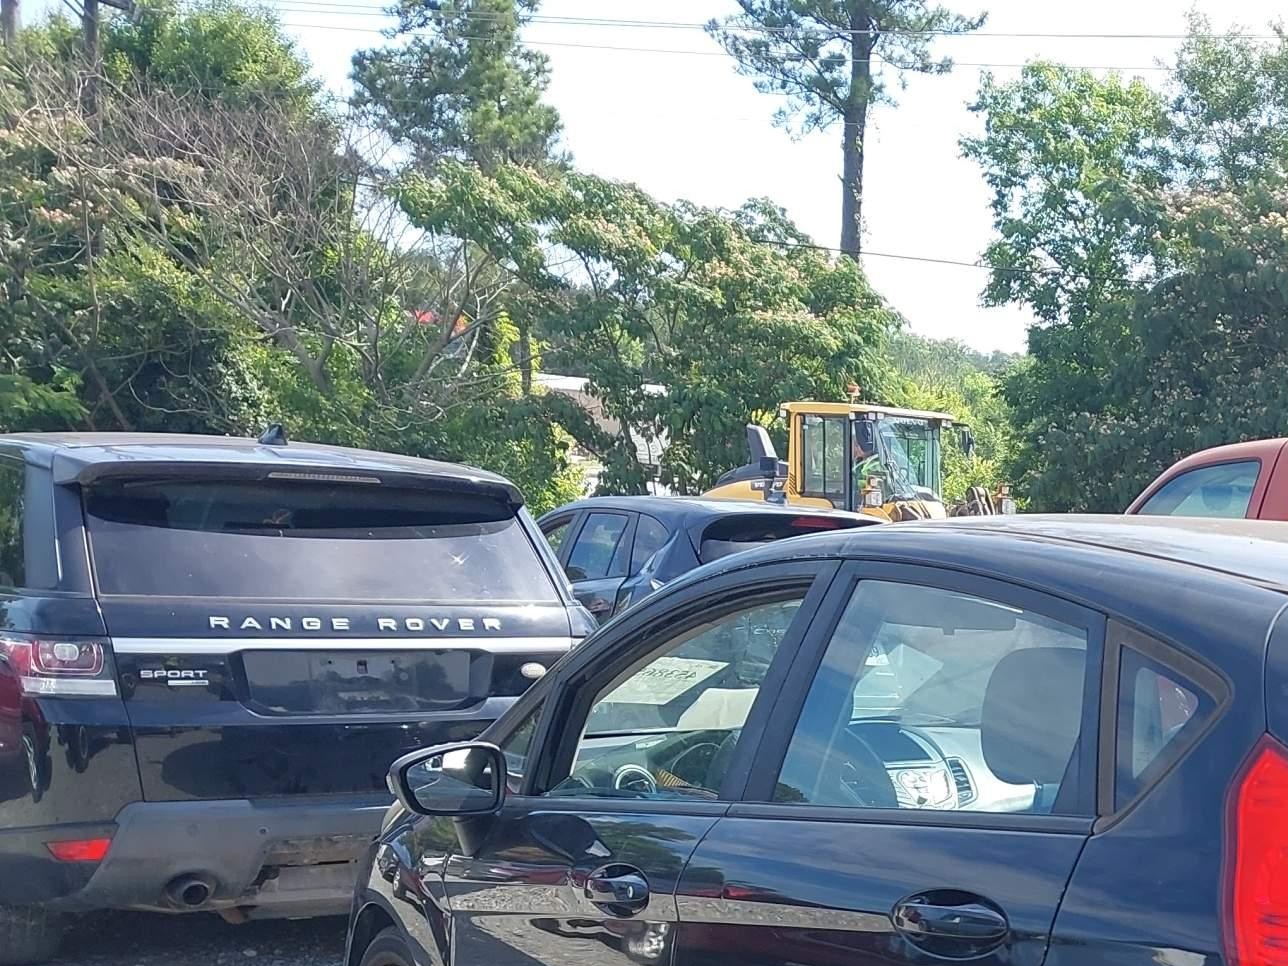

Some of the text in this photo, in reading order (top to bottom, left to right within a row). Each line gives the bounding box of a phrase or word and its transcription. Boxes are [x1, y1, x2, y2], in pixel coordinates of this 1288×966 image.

[209, 616, 501, 631] RANGE ROVER
[140, 669, 208, 679] SPORT
